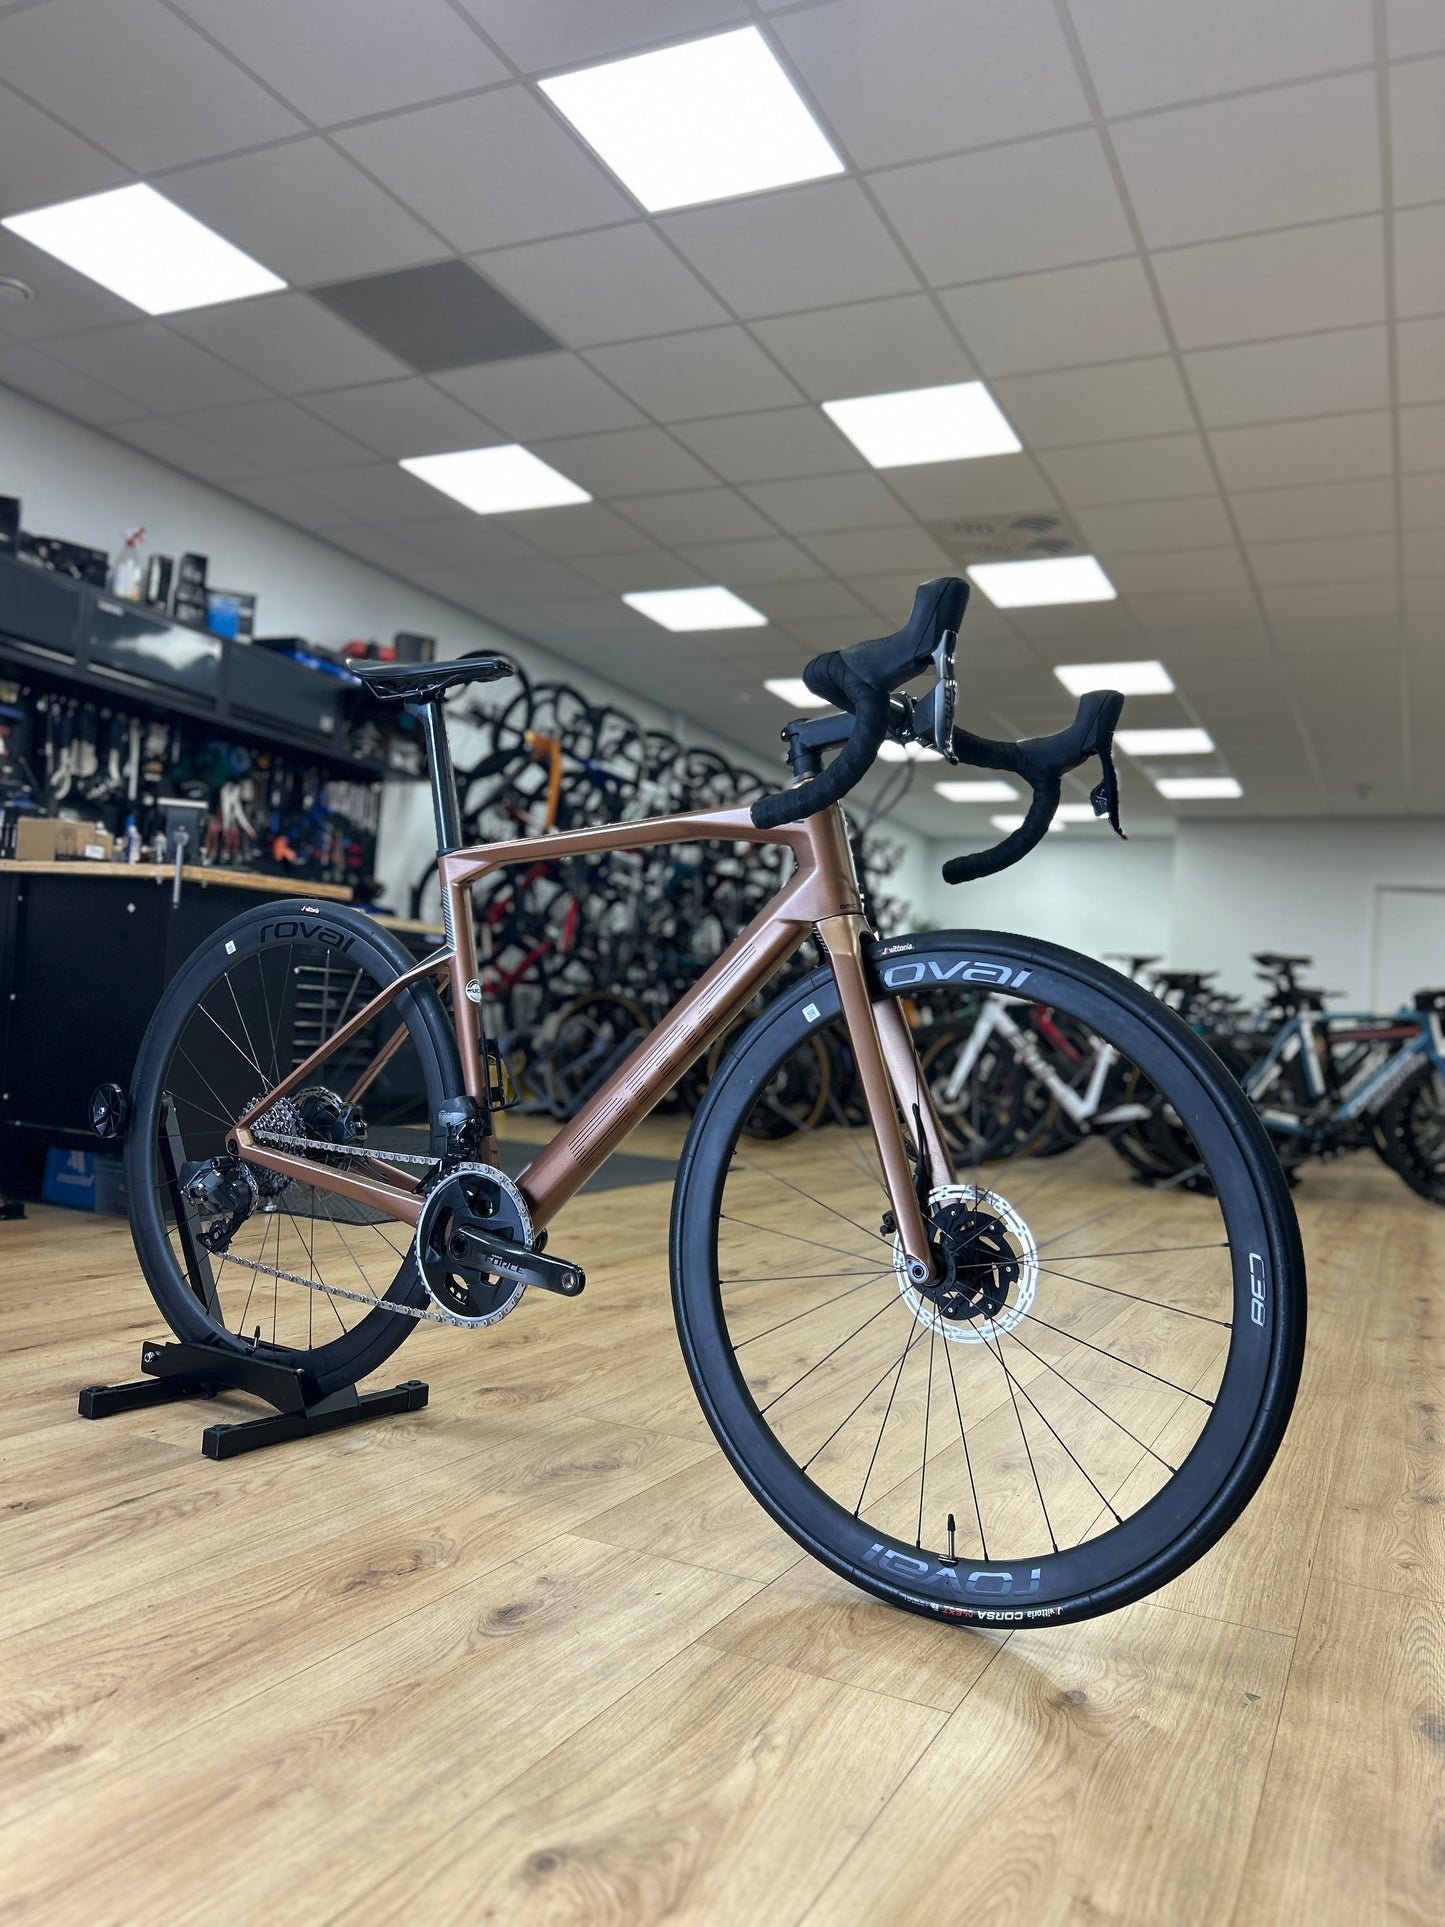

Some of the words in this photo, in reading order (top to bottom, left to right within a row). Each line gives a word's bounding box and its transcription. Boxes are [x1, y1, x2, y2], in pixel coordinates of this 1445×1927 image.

[260, 921, 357, 953] roval
[881, 960, 1034, 989] oval
[484, 1255, 524, 1275] FORCE
[1249, 1252, 1266, 1328] C38
[860, 1542, 1042, 1597] roval
[977, 1610, 1024, 1621] CORSA
[1027, 1607, 1056, 1620] vittoria
